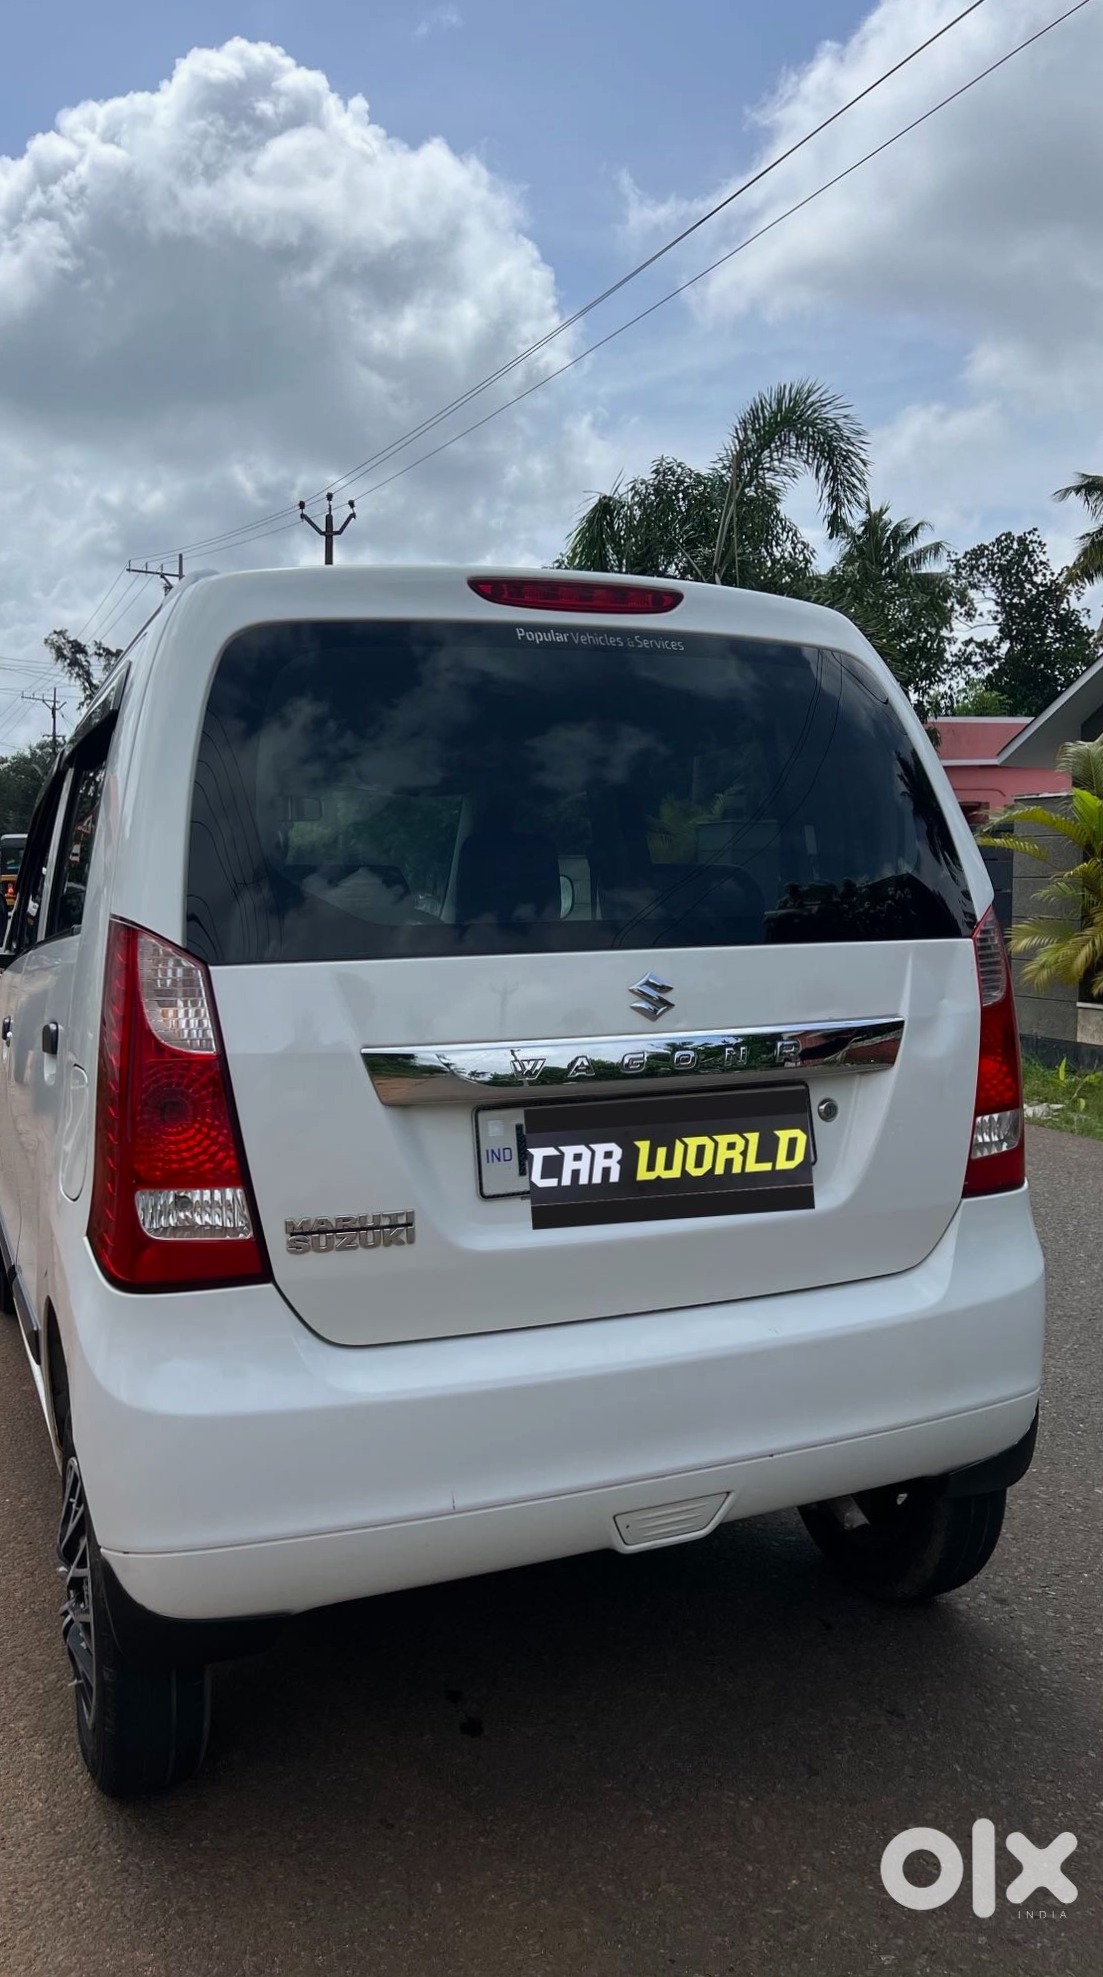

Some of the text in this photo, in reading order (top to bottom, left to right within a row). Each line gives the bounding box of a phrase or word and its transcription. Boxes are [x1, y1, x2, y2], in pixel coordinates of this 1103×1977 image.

[516, 627, 569, 644] Popular
[570, 631, 624, 648] Vehicles
[635, 635, 684, 650] Services
[486, 1147, 513, 1164] IND
[285, 1210, 415, 1235] MARUTI
[286, 1226, 416, 1255] SUZUKI
